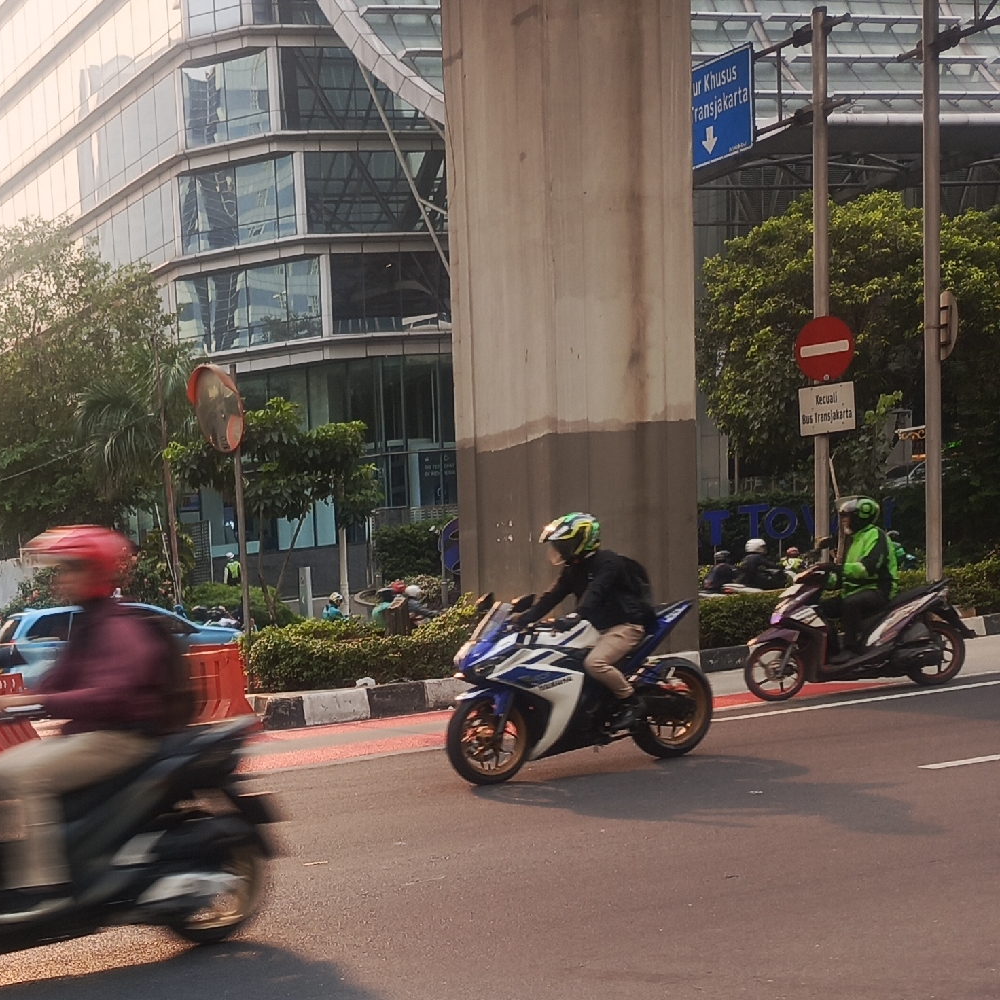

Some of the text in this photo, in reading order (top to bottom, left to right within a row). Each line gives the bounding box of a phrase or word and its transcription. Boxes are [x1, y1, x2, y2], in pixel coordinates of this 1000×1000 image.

[704, 65, 737, 93] Khusus
[691, 86, 748, 123] ransjakarta
[815, 391, 838, 406] Kecuali
[802, 408, 853, 425] Bus Transjakarta
